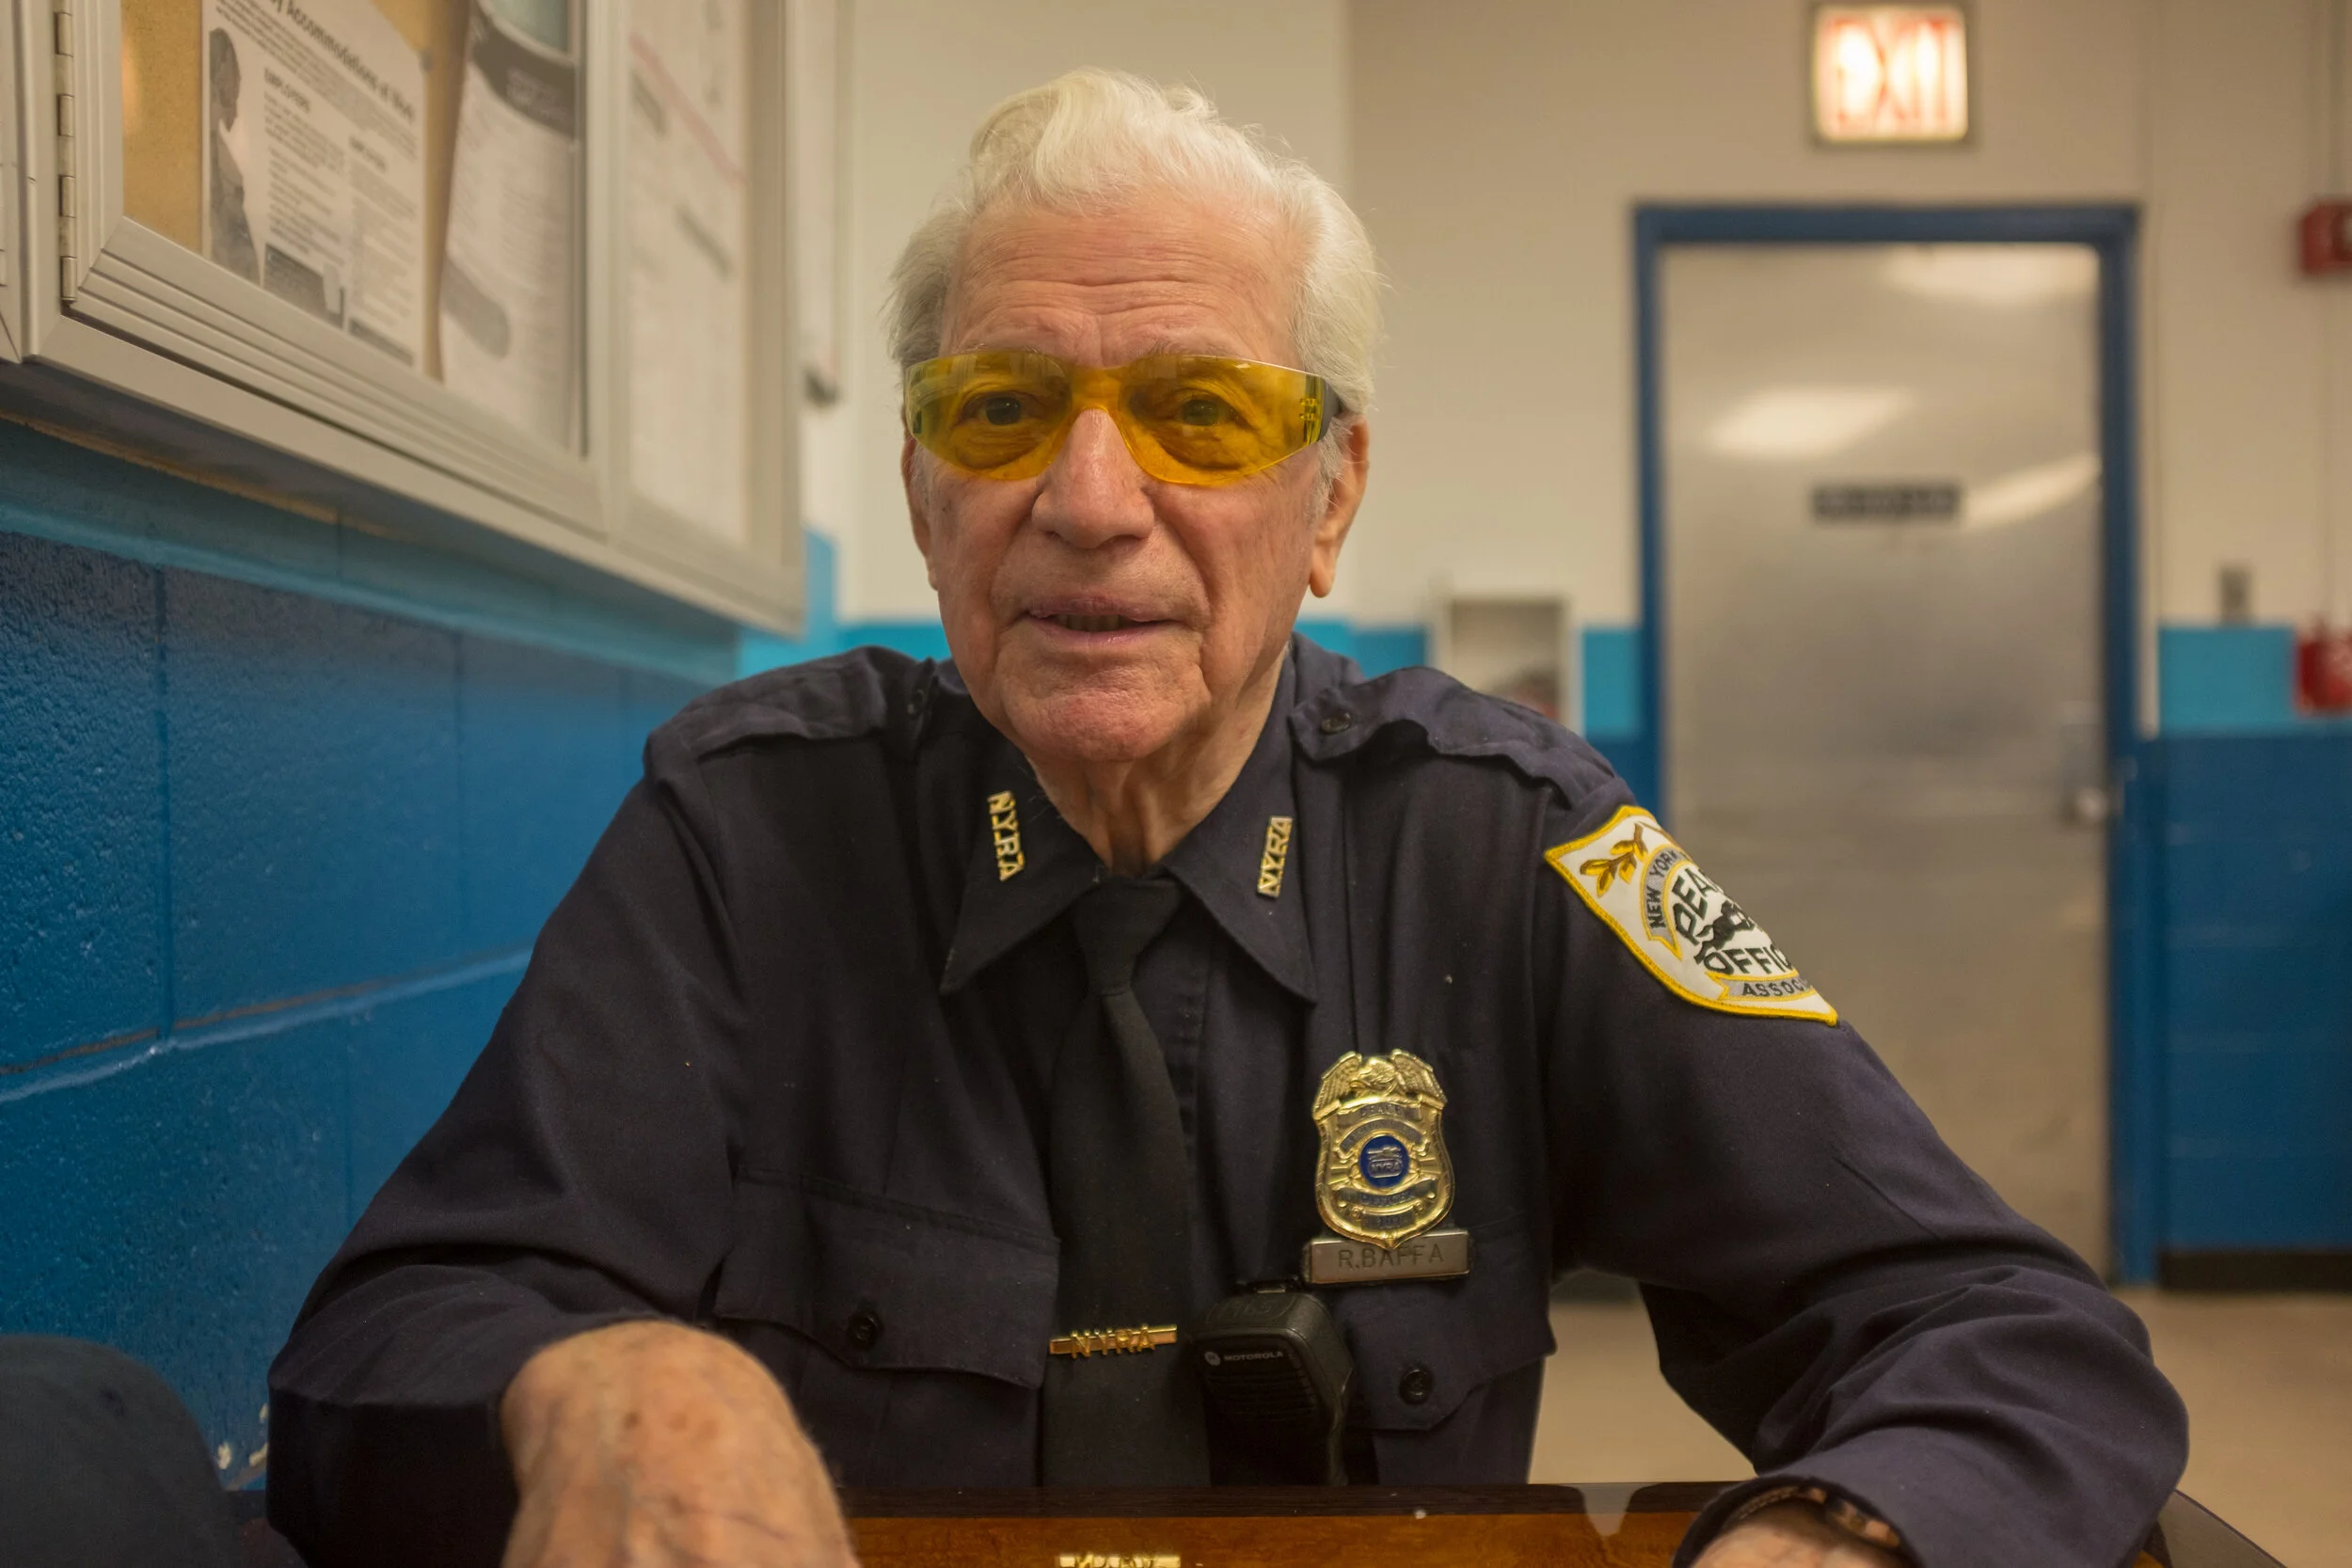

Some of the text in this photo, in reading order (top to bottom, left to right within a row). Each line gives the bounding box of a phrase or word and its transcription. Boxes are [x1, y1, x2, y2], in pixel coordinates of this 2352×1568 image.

[1825, 16, 1966, 129] EXIT
[988, 791, 1024, 881] NYRA
[1258, 816, 1293, 897] NYRA
[1646, 849, 1678, 929] NEW YORK
[1671, 867, 1724, 946] PEA
[1337, 1243, 1446, 1270] R.BAFFA
[1223, 1351, 1284, 1362] MOTOROLA
